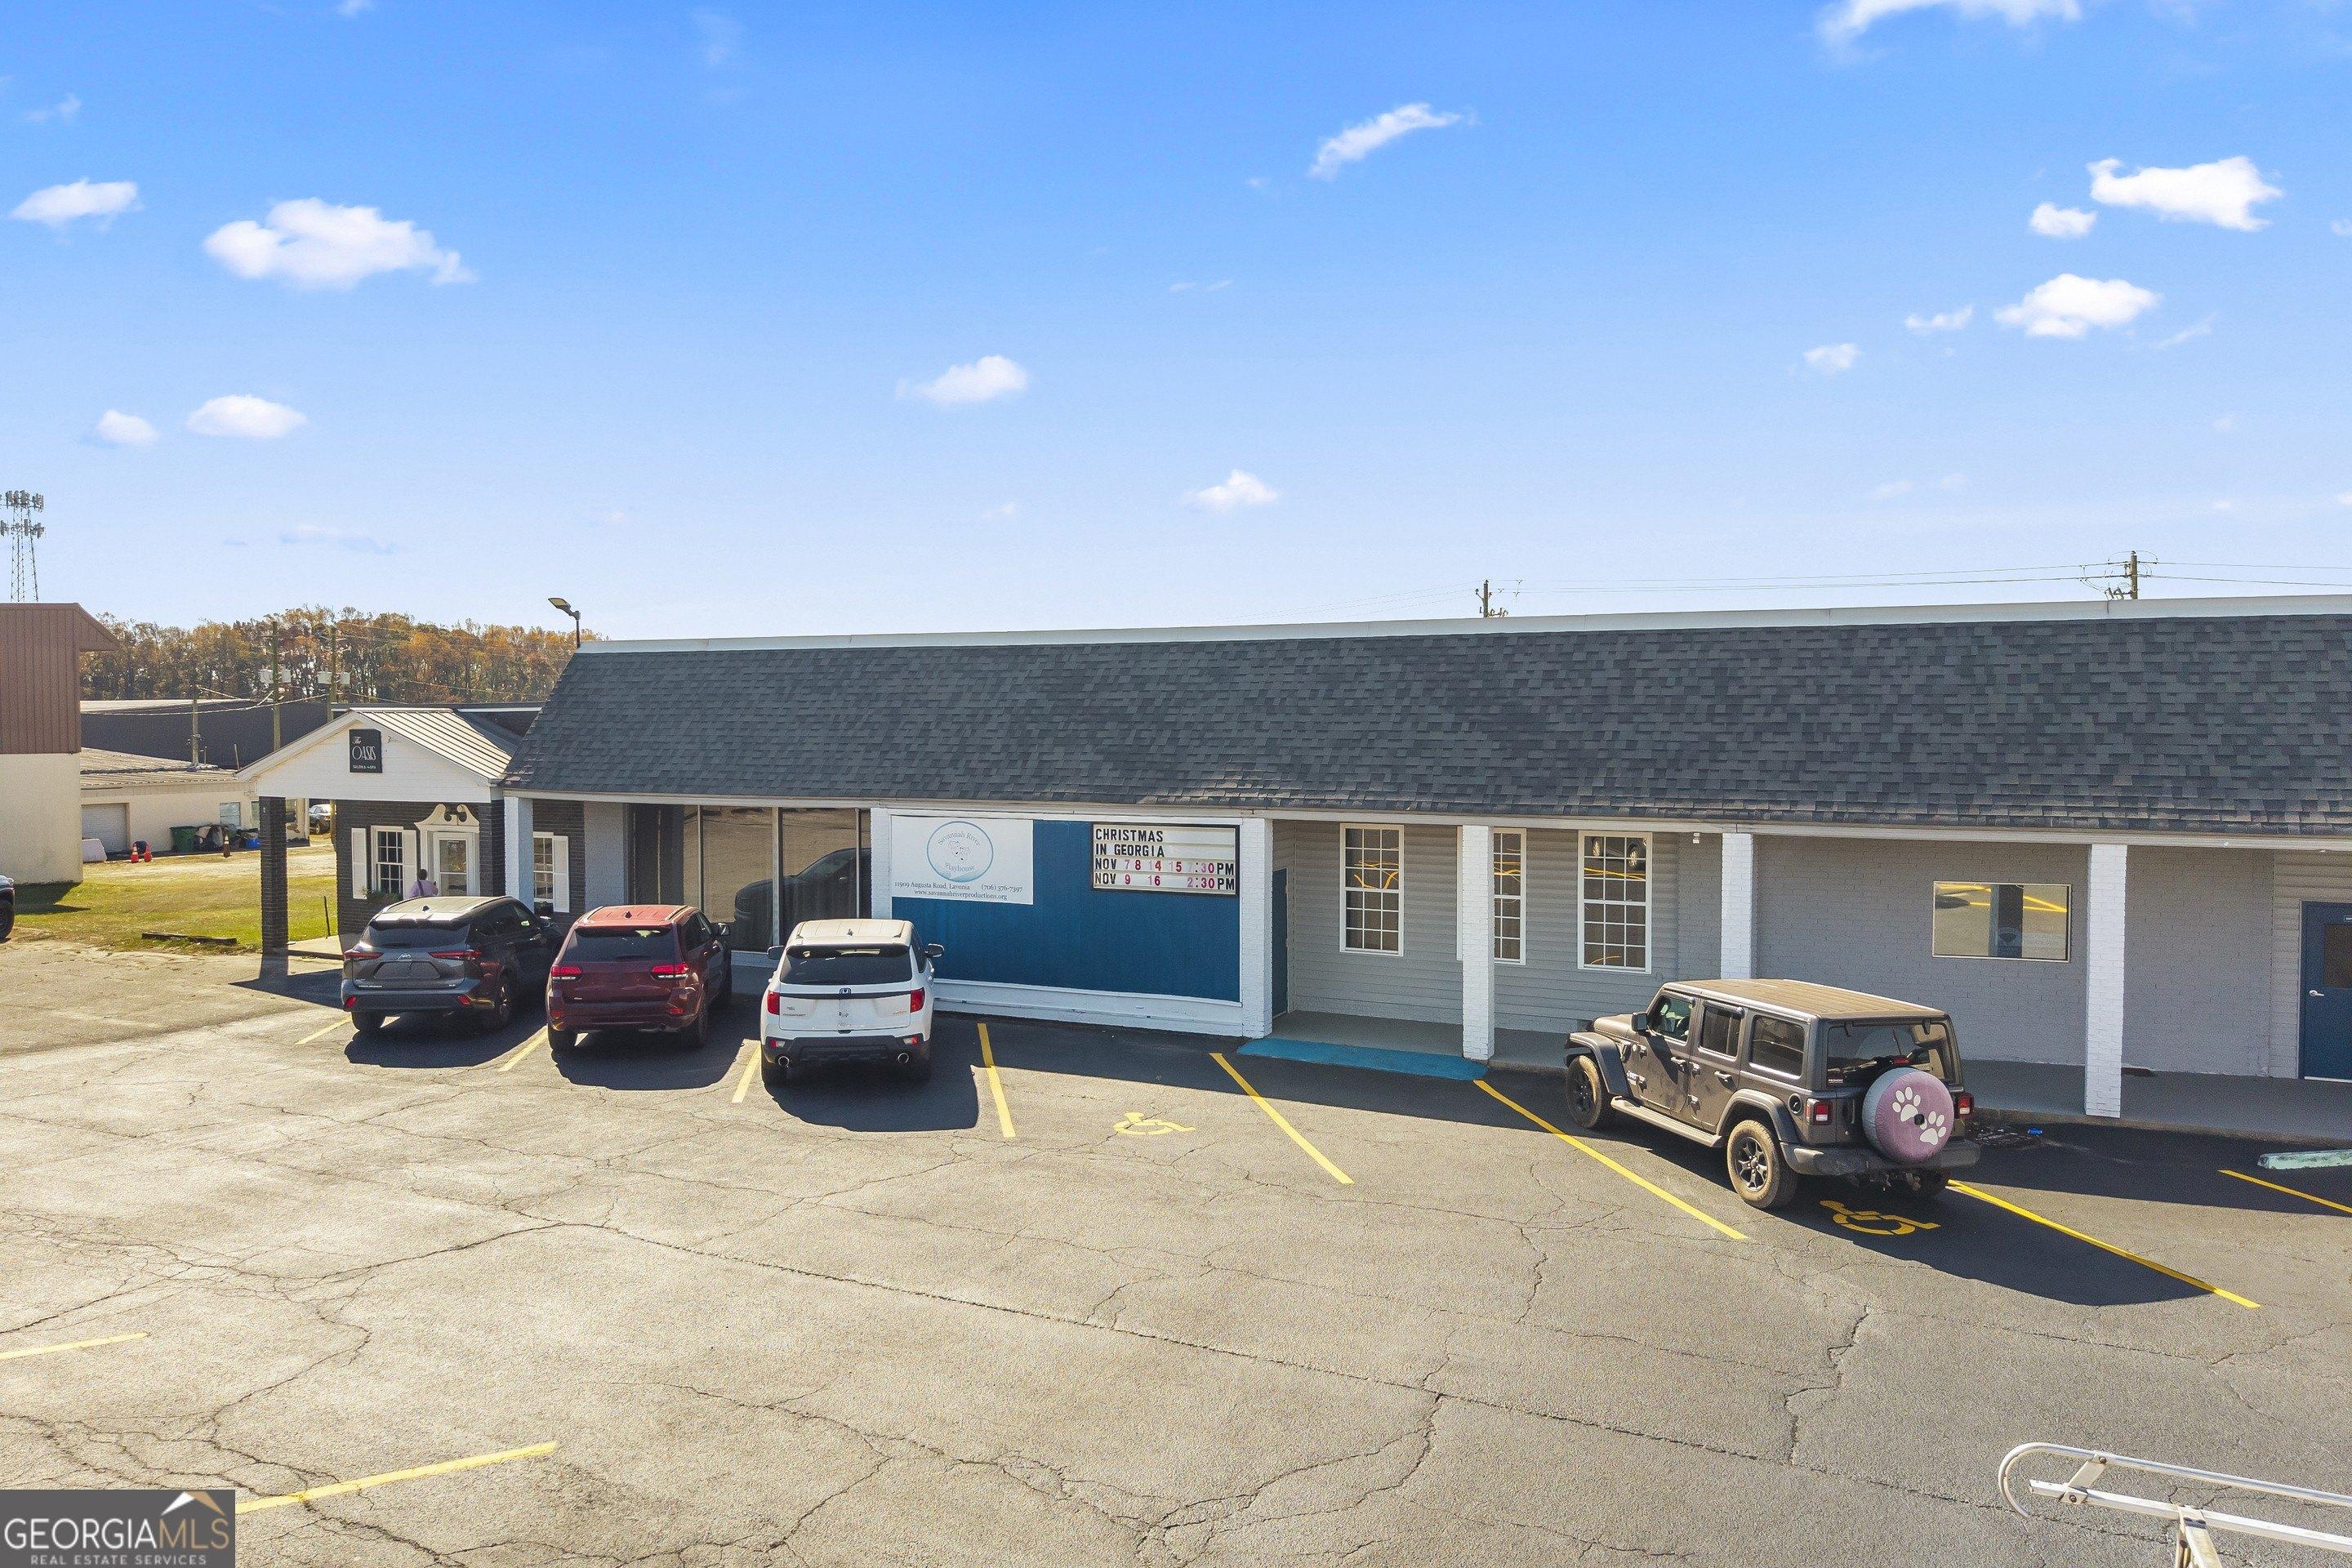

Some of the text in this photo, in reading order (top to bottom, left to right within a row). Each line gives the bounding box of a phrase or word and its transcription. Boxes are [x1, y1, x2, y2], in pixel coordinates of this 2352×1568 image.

[352, 745, 376, 760] OASIS
[938, 831, 981, 846] Savannah River
[1095, 828, 1164, 843] CHRISTMAS
[1095, 844, 1165, 857] IN GEORGIA
[945, 862, 974, 873] Playhouse
[1095, 858, 1117, 870] NOV
[1124, 859, 1130, 870] 7
[1134, 859, 1141, 871] 8
[1094, 872, 1116, 884] NOV
[1124, 874, 1131, 885] 9
[1147, 875, 1160, 886] 16
[914, 890, 1008, 901] www.savannahriverproductions.org
